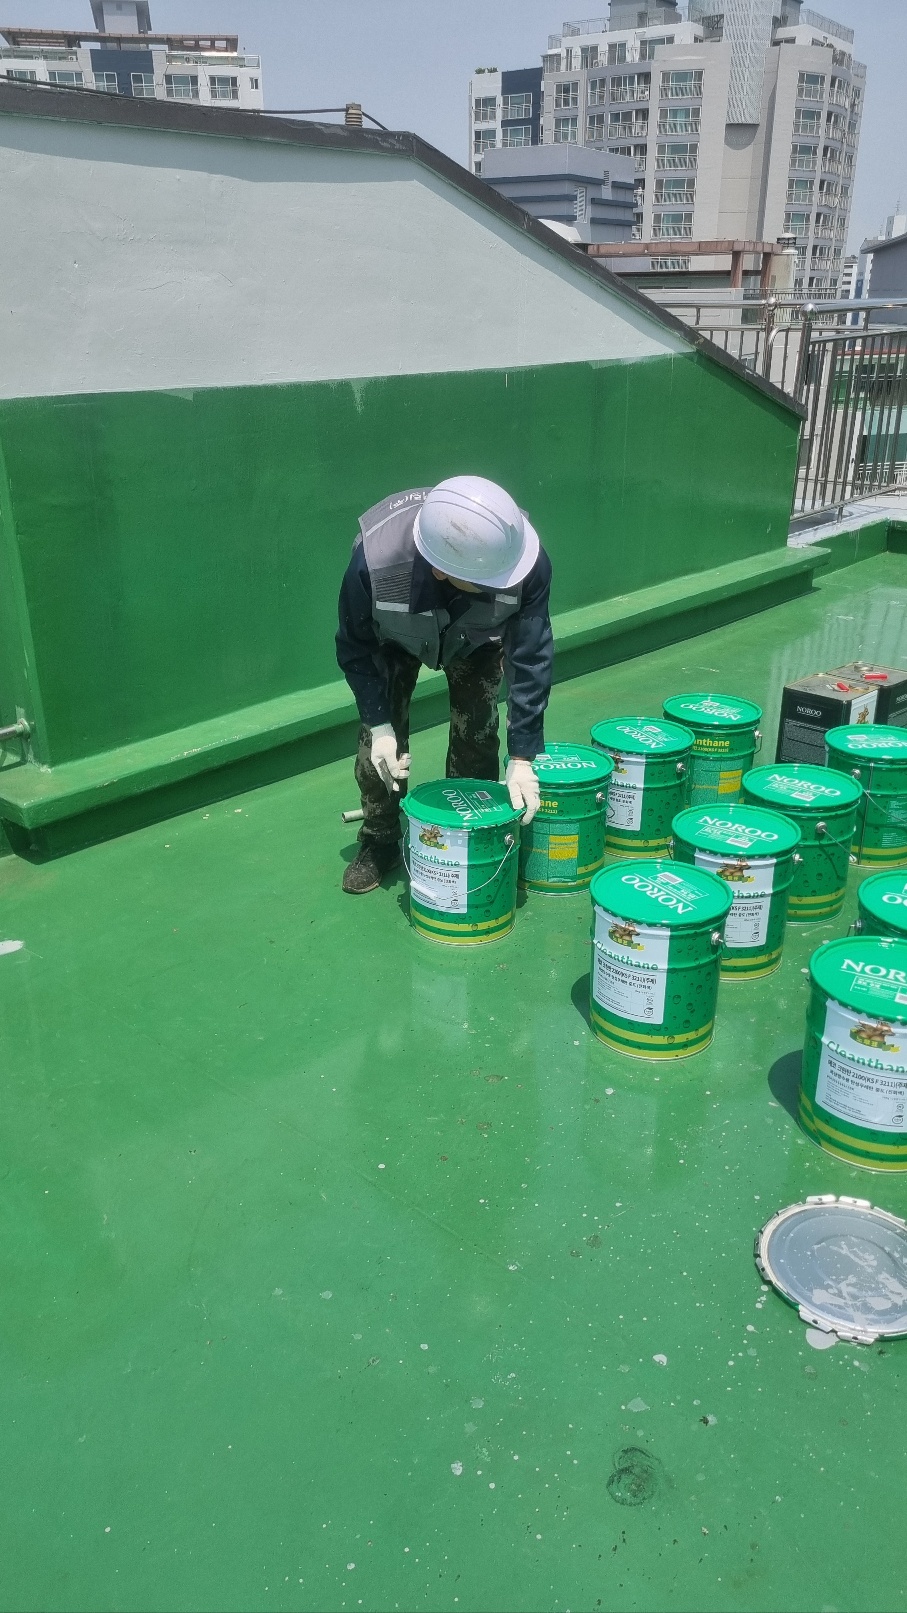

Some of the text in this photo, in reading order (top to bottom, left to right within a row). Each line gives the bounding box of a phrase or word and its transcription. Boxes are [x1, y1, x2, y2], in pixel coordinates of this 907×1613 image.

[680, 703, 743, 720] NOROO
[797, 705, 822, 717] NOROO
[616, 726, 663, 748] NOROO
[766, 774, 841, 796] NOROO
[442, 790, 478, 820] NOROO
[699, 816, 778, 840] NOROO
[621, 875, 693, 914] NOROO
[595, 940, 659, 971] Cleanthane
[827, 1040, 907, 1073] Cleanthan
